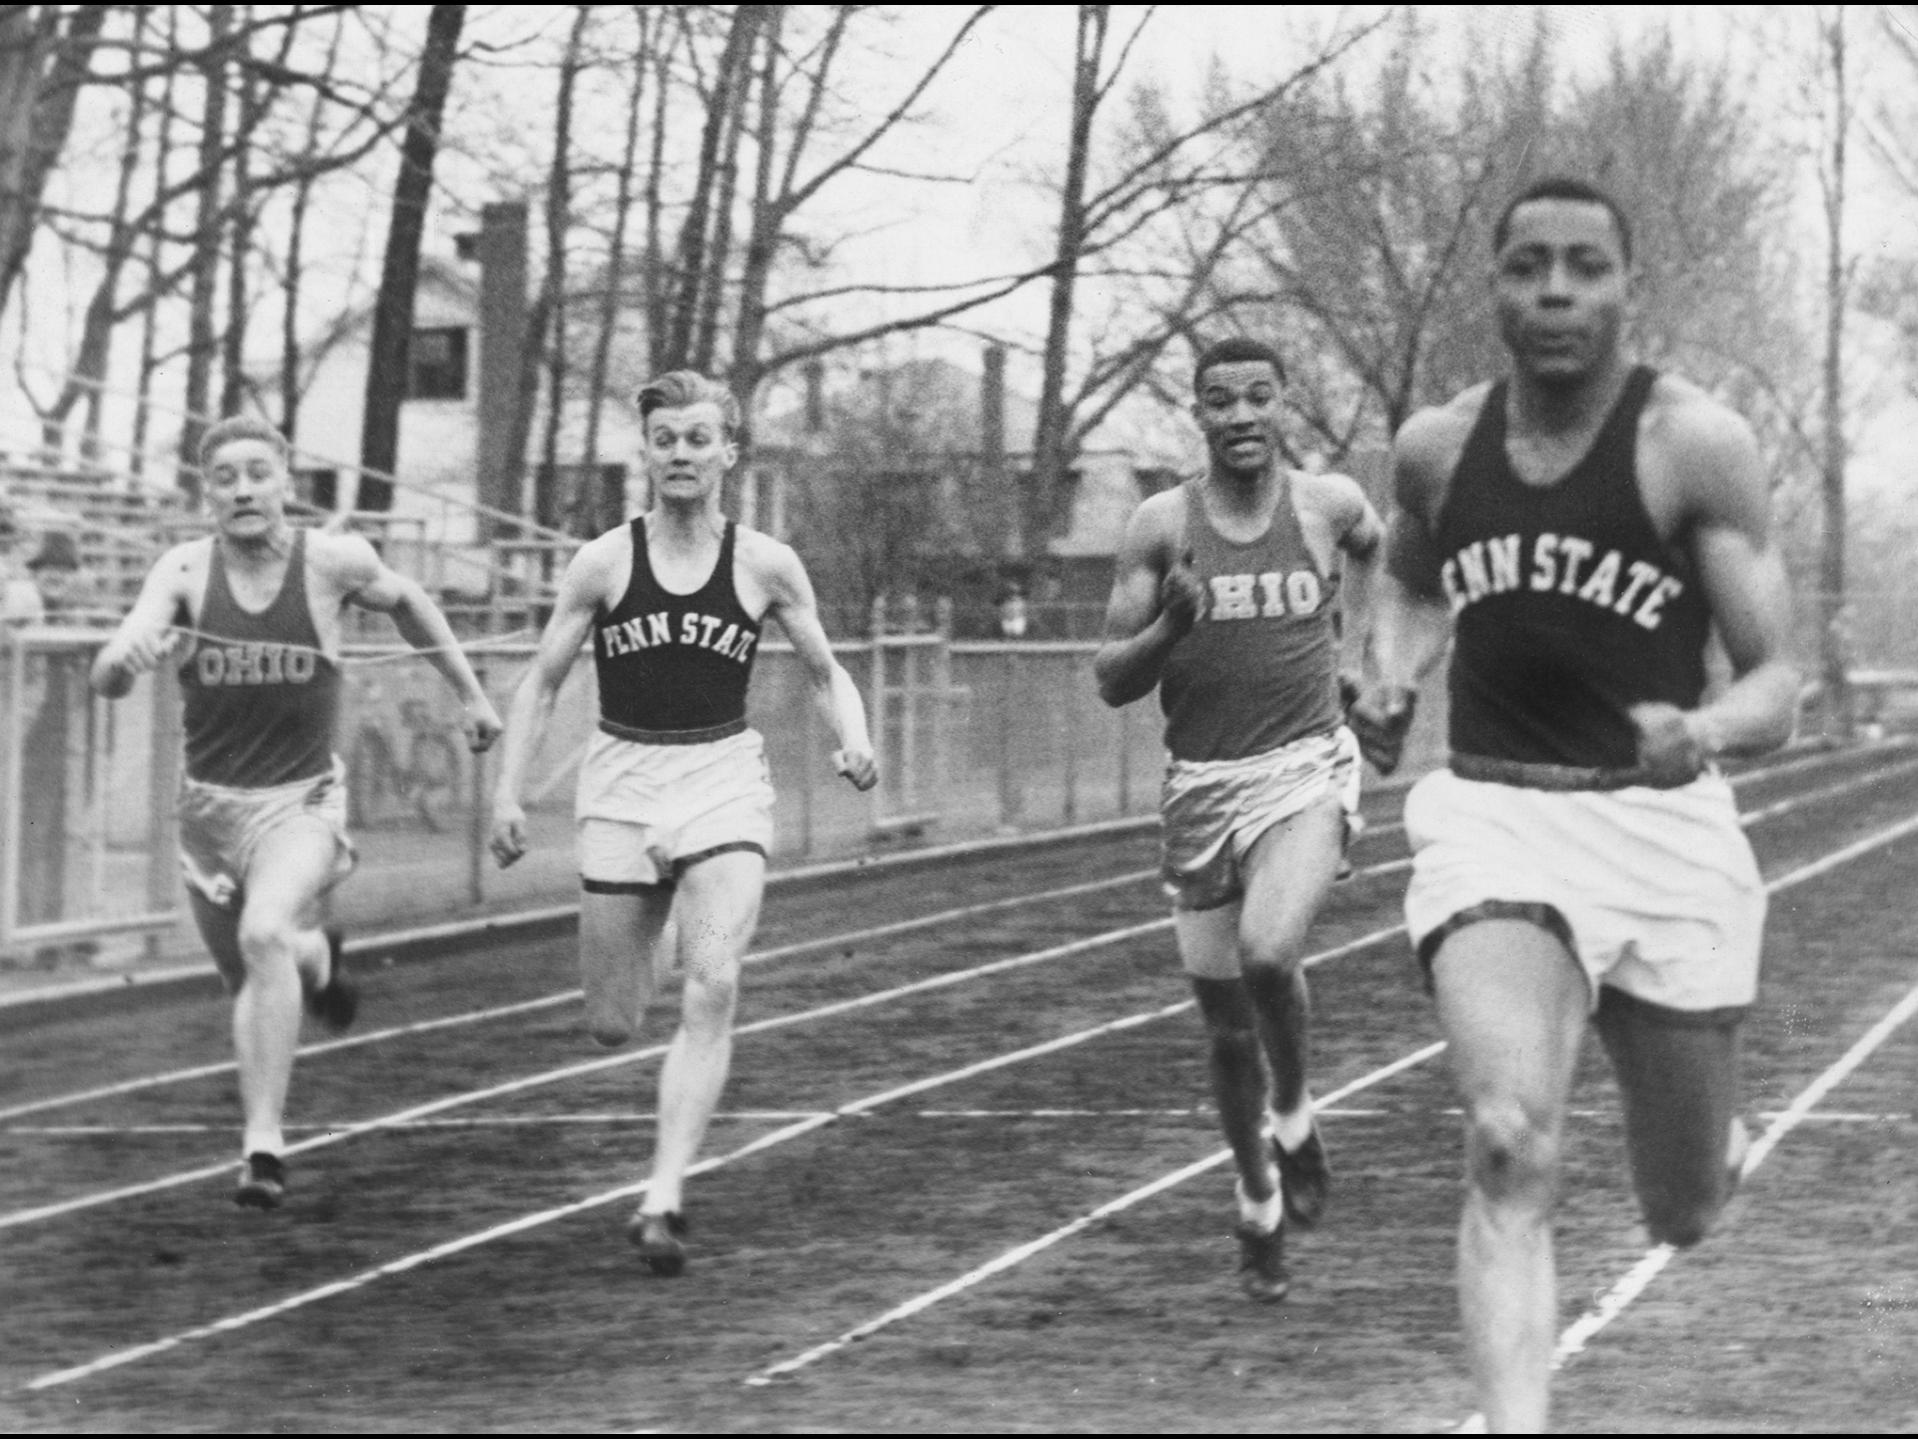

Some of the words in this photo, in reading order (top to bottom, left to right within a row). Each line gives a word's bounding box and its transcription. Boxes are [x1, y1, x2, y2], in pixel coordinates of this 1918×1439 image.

[1194, 570, 1322, 622] HIO
[1441, 533, 1521, 611] ENN
[1530, 532, 1684, 630] STATE
[602, 611, 672, 658] PENN
[199, 646, 316, 686] OHIO
